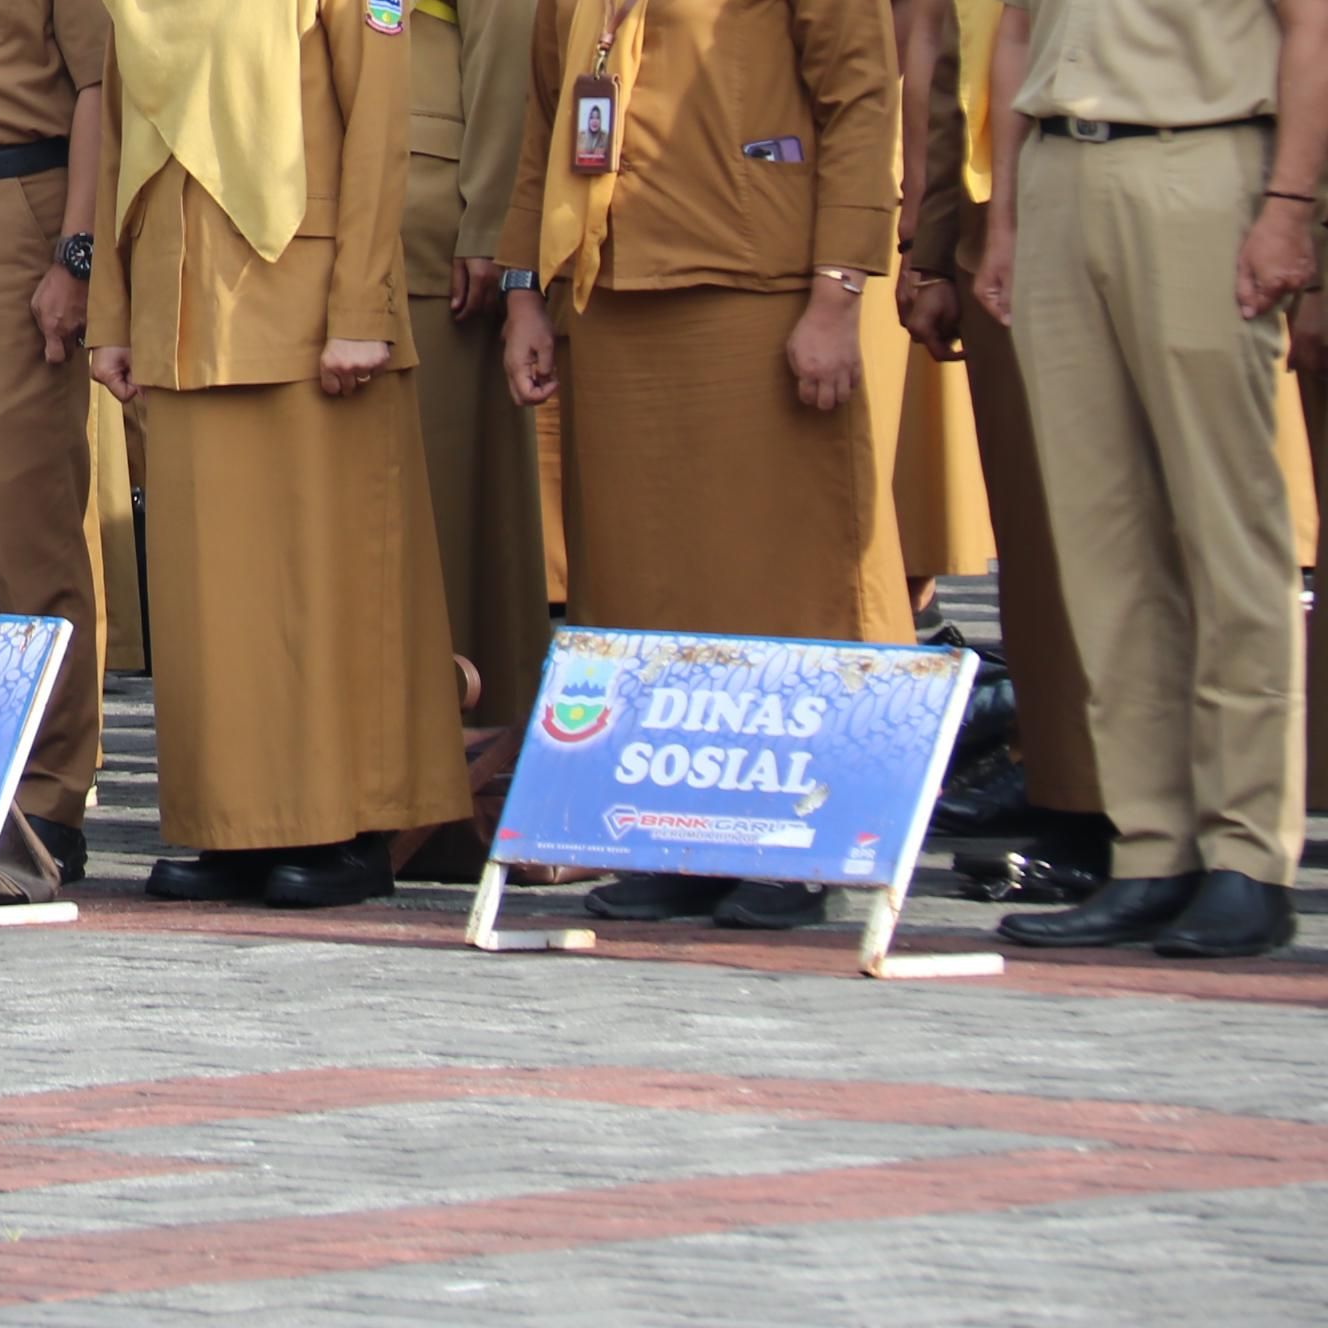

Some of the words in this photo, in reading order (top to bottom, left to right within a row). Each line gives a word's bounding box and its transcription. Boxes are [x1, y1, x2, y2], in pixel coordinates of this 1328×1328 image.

[641, 687, 828, 738] DINAS
[615, 741, 817, 795] SOSIAL
[640, 814, 708, 829] BANK
